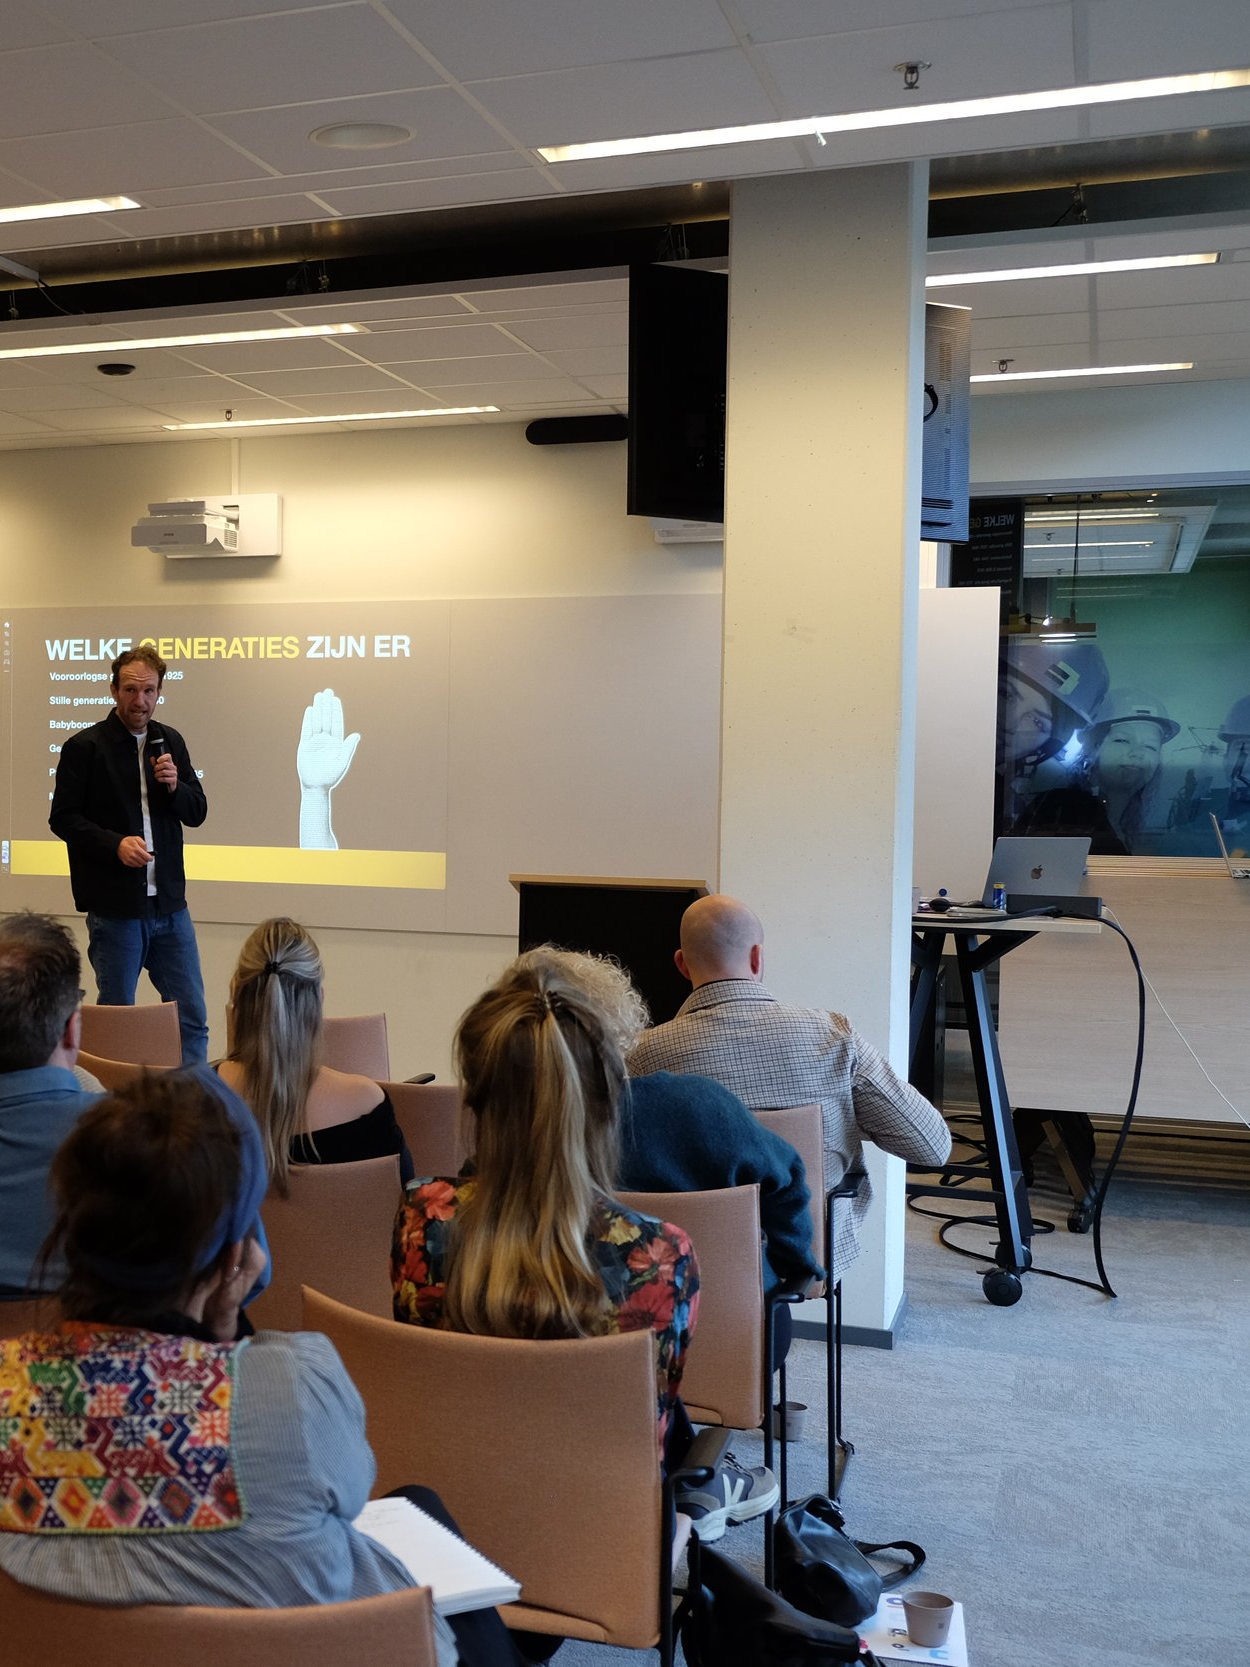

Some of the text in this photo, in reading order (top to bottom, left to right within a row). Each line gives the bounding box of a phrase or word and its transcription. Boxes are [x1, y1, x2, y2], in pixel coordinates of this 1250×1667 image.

[45, 638, 132, 660] WELKE
[306, 635, 365, 658] ZIJN
[374, 635, 411, 657] ER
[49, 672, 108, 682] Vooroorlogse
[49, 695, 71, 705] Stille
